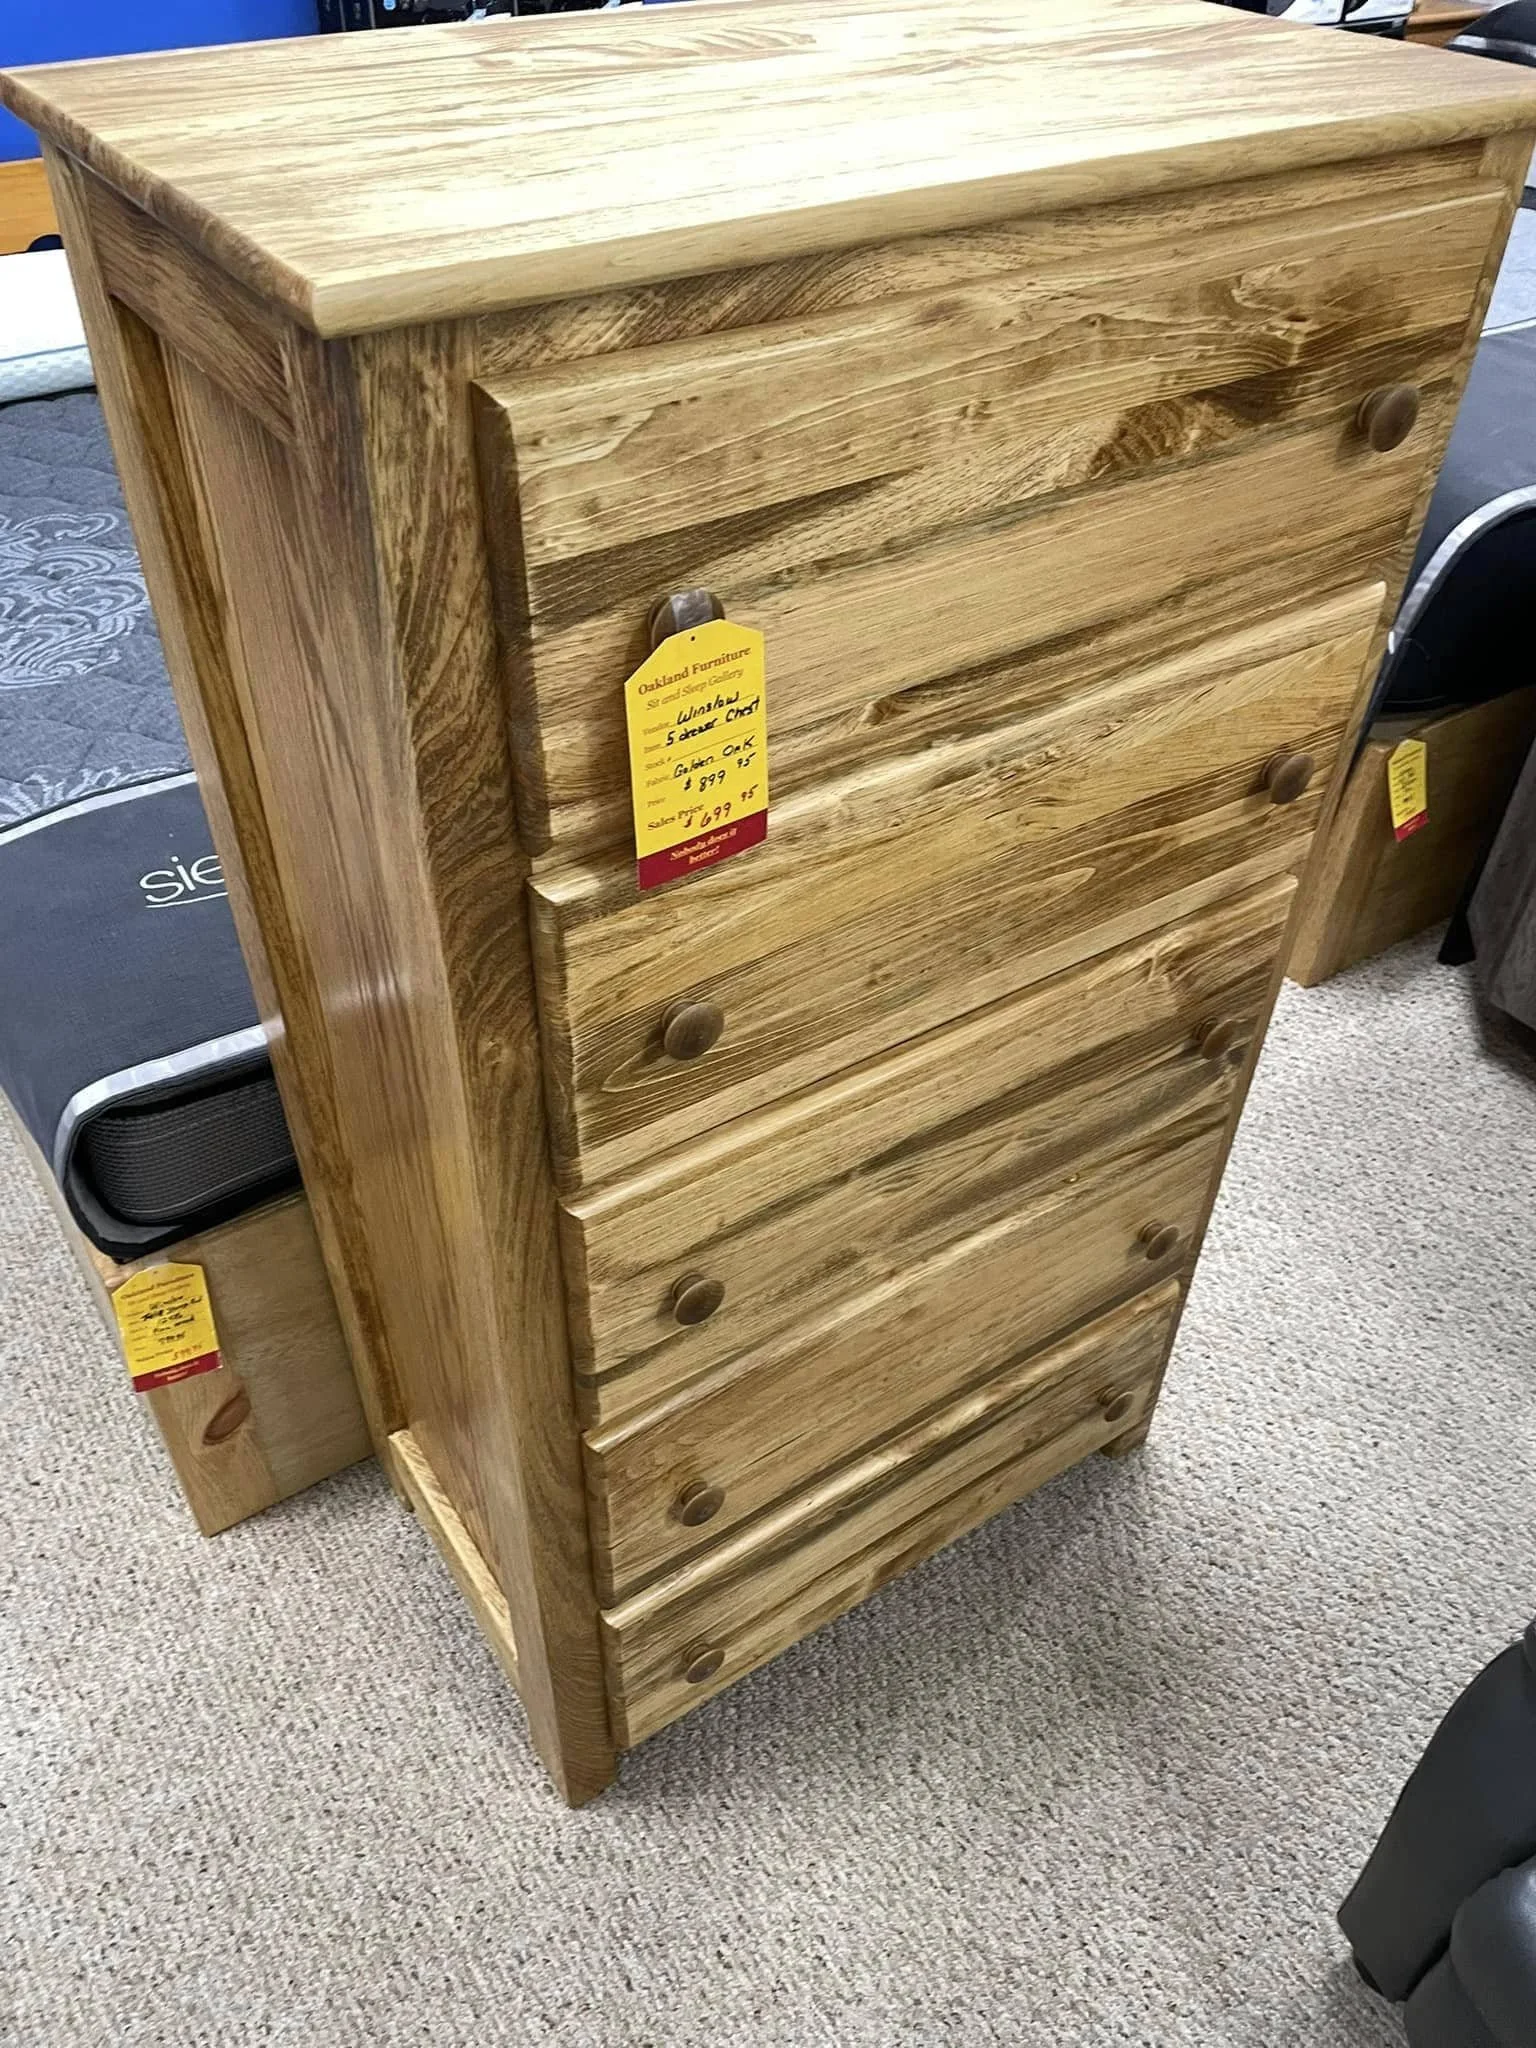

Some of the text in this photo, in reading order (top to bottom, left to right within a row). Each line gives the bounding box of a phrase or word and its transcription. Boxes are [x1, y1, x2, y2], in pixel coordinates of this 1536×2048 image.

[638, 647, 752, 695] Oakland Furniture
[661, 688, 681, 705] and
[681, 681, 708, 698] Sleep
[708, 668, 745, 687] Gallery
[665, 730, 676, 747] 5
[725, 695, 761, 723] Chest
[676, 691, 740, 726] Winslow
[673, 755, 714, 779] Golden
[736, 751, 757, 769] 95
[740, 783, 759, 802] 95
[647, 803, 705, 831] Sales Price
